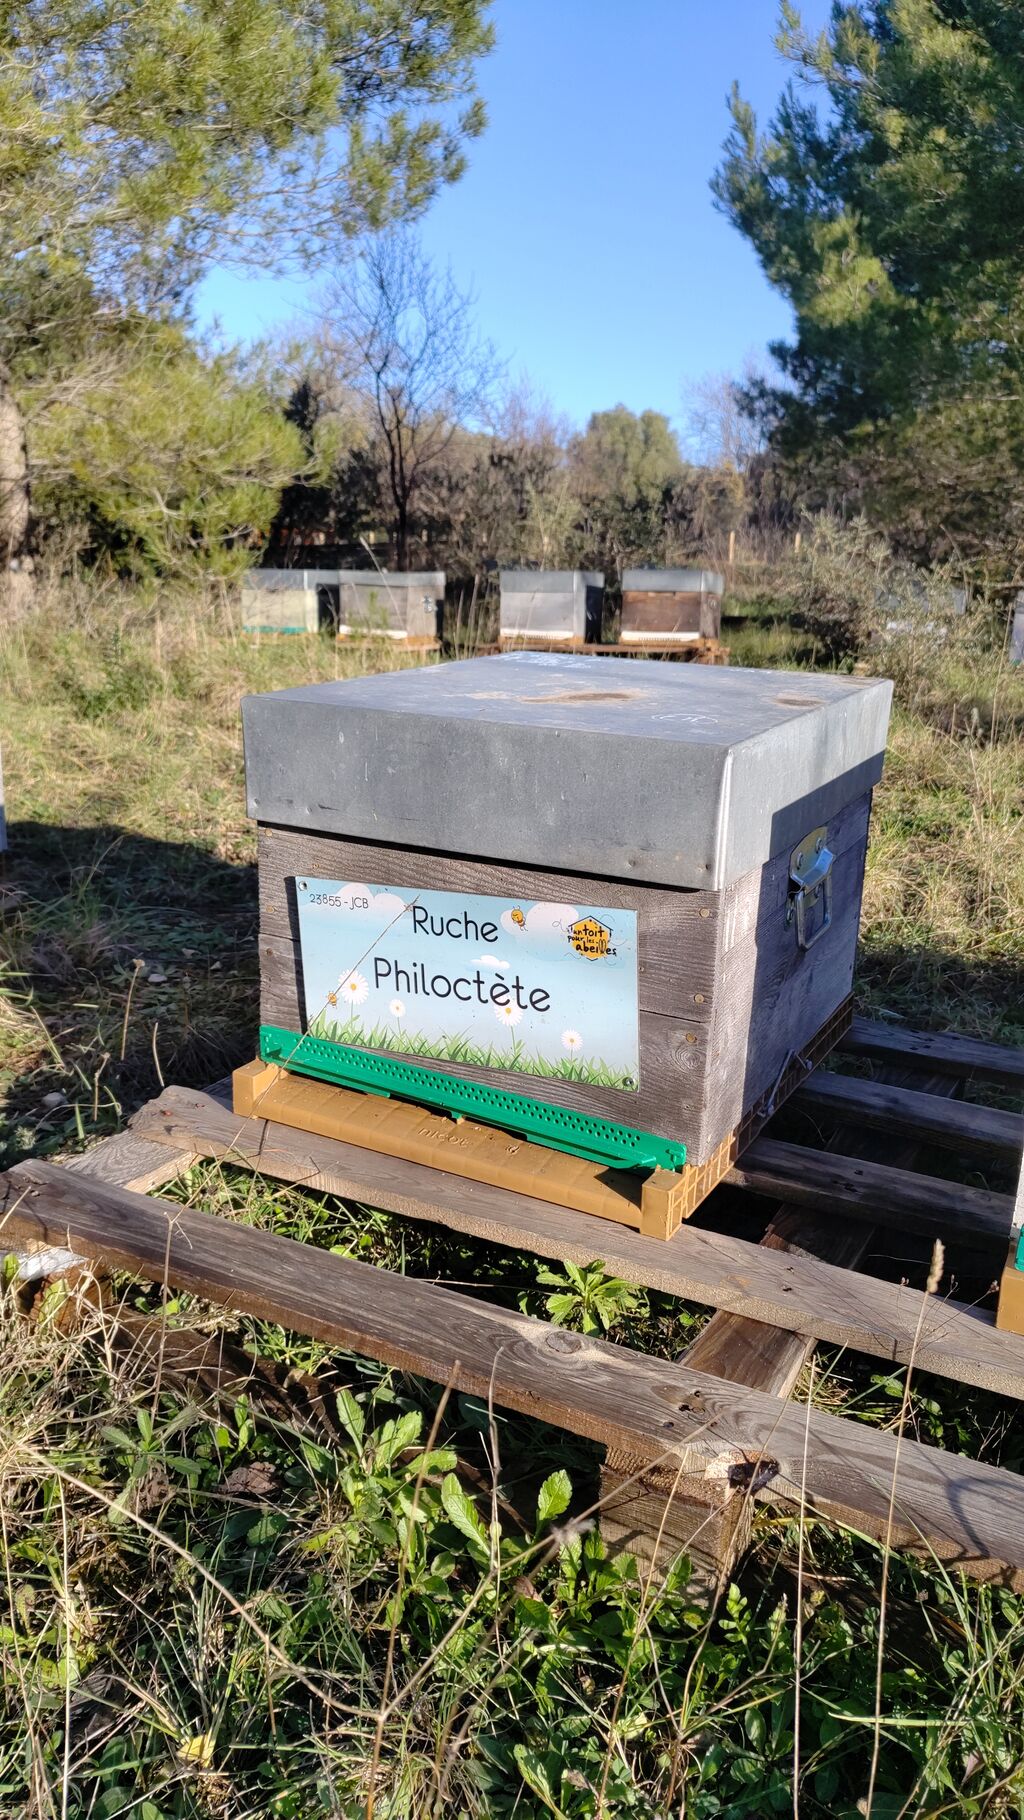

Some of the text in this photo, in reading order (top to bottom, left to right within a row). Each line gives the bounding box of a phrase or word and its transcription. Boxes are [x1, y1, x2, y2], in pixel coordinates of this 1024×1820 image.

[412, 905, 499, 943] Ruche
[583, 923, 605, 937] toit
[575, 938, 618, 957] abeilles
[374, 956, 551, 1013] Philoctète
